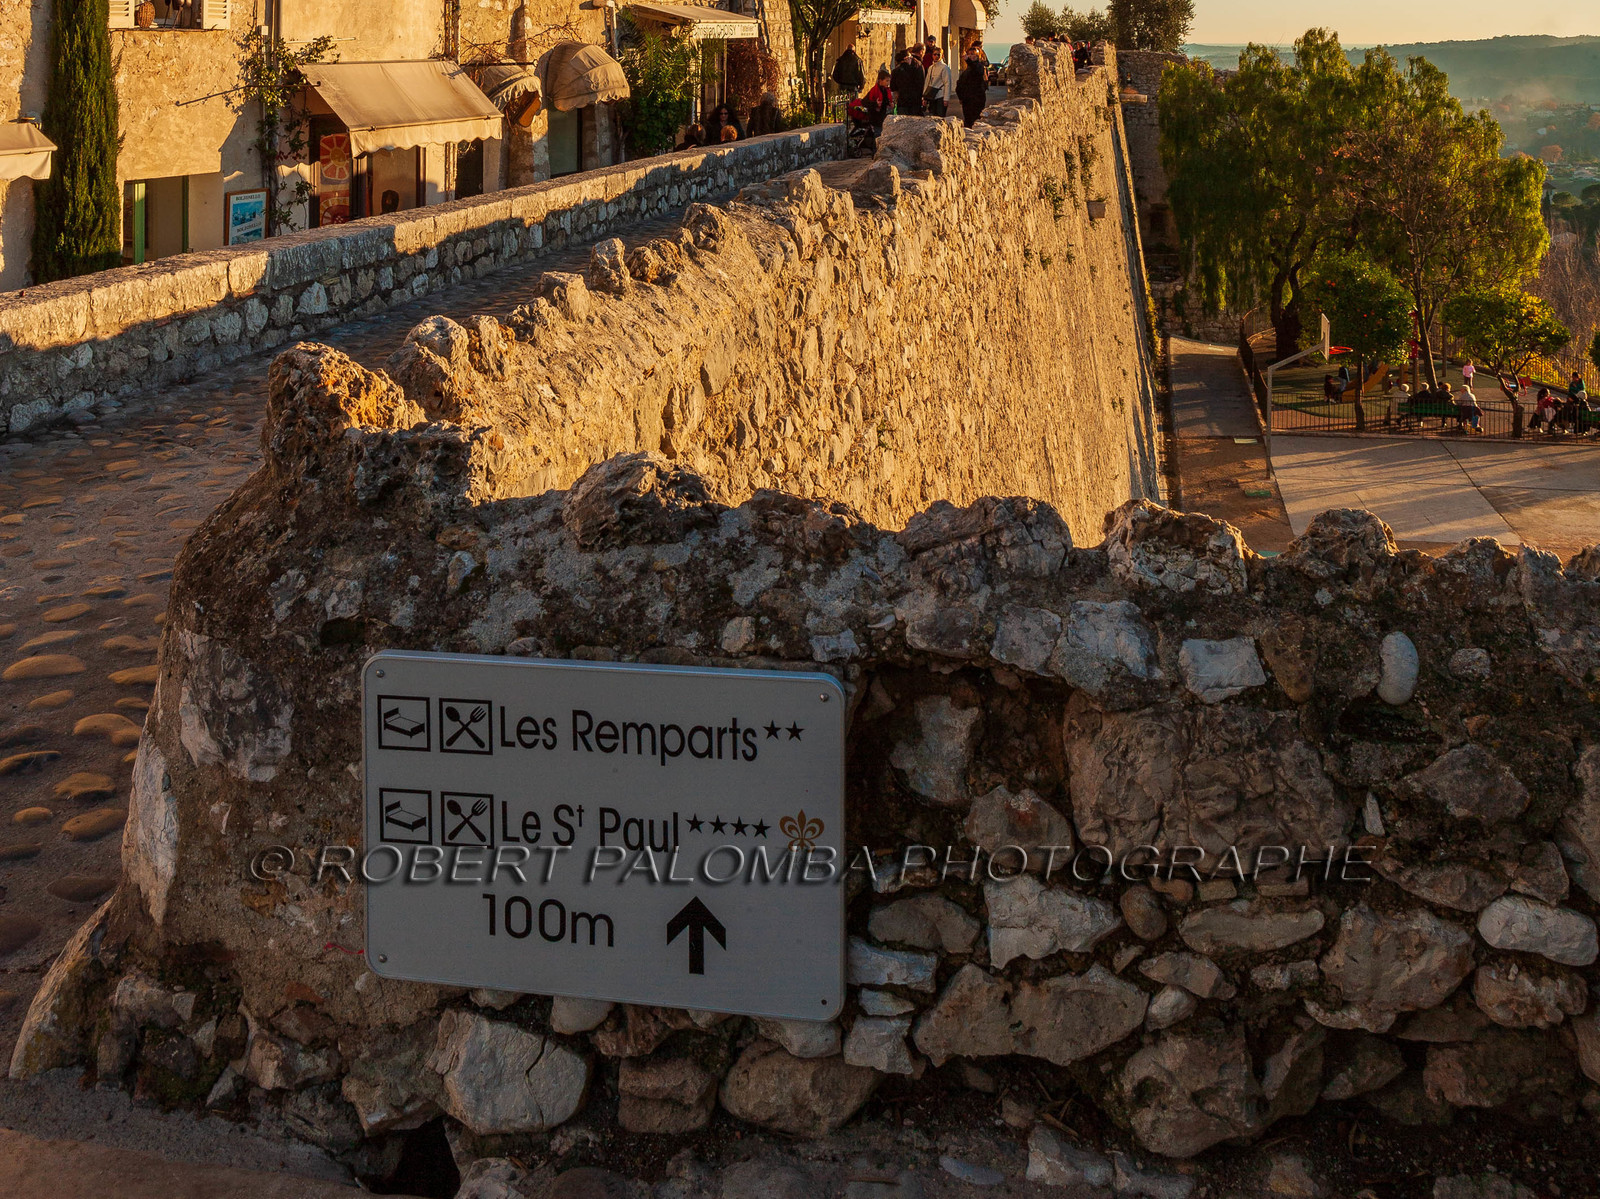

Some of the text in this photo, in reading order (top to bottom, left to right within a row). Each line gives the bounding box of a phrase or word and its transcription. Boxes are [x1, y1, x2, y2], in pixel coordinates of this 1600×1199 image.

[500, 706, 758, 766] Les Remparts
[502, 801, 541, 844] Le
[599, 807, 679, 854] Paul
[482, 893, 615, 948] 100m
